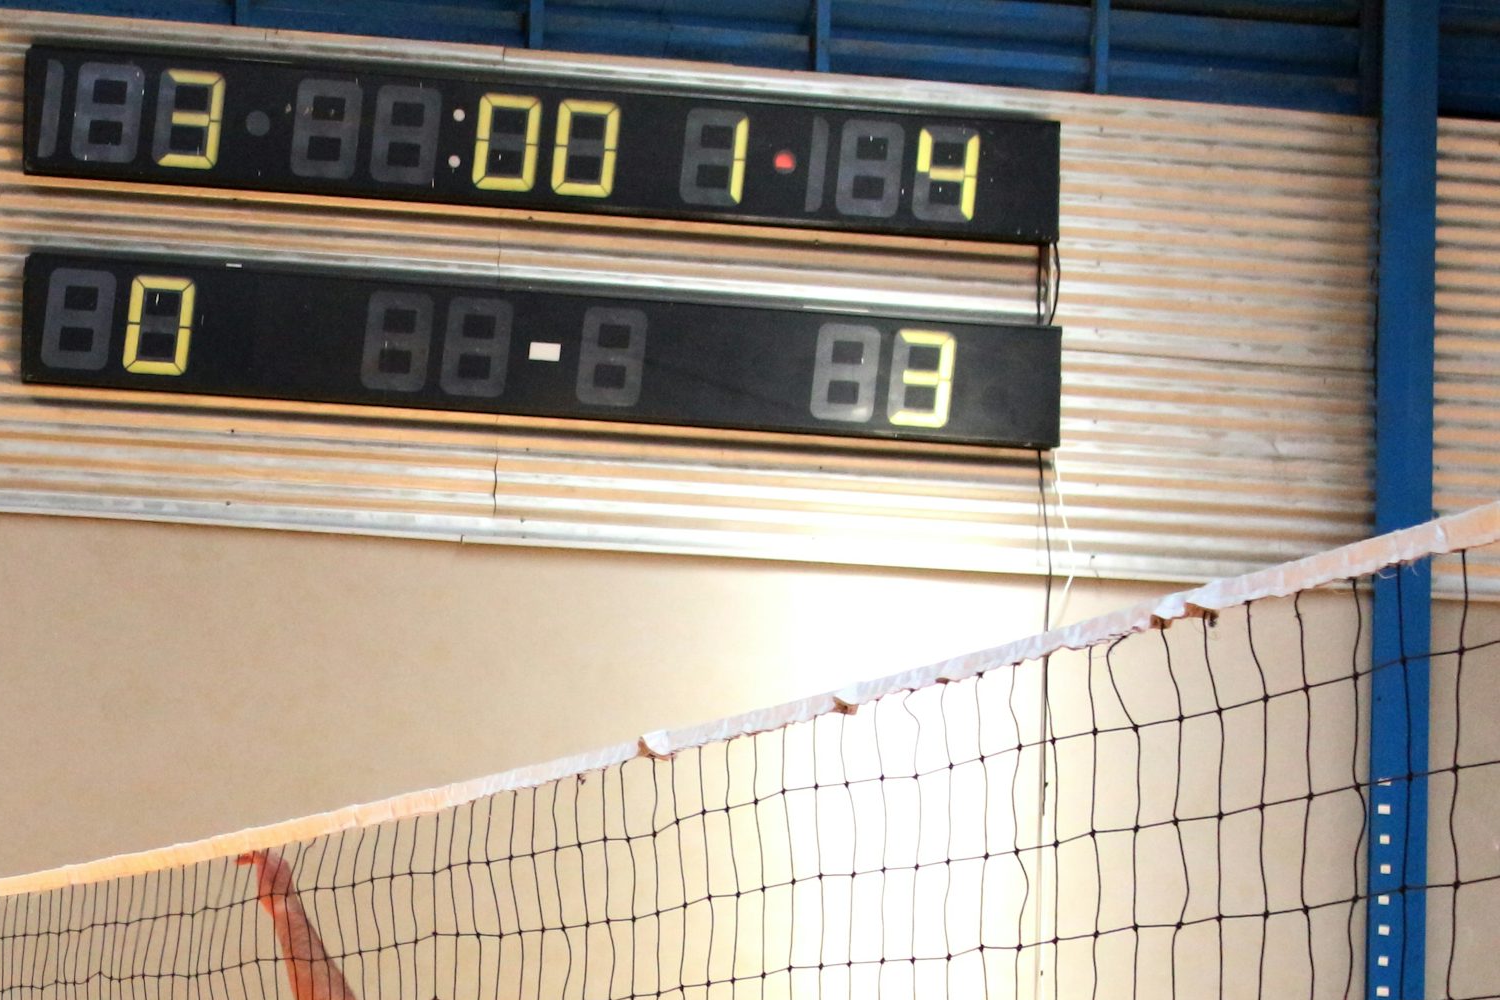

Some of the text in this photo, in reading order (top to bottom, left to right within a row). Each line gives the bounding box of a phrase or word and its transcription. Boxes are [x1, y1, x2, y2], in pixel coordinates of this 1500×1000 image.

[157, 69, 226, 169] 3
[729, 116, 750, 205] 1
[916, 128, 981, 222] 4
[122, 275, 956, 429] 0 3
